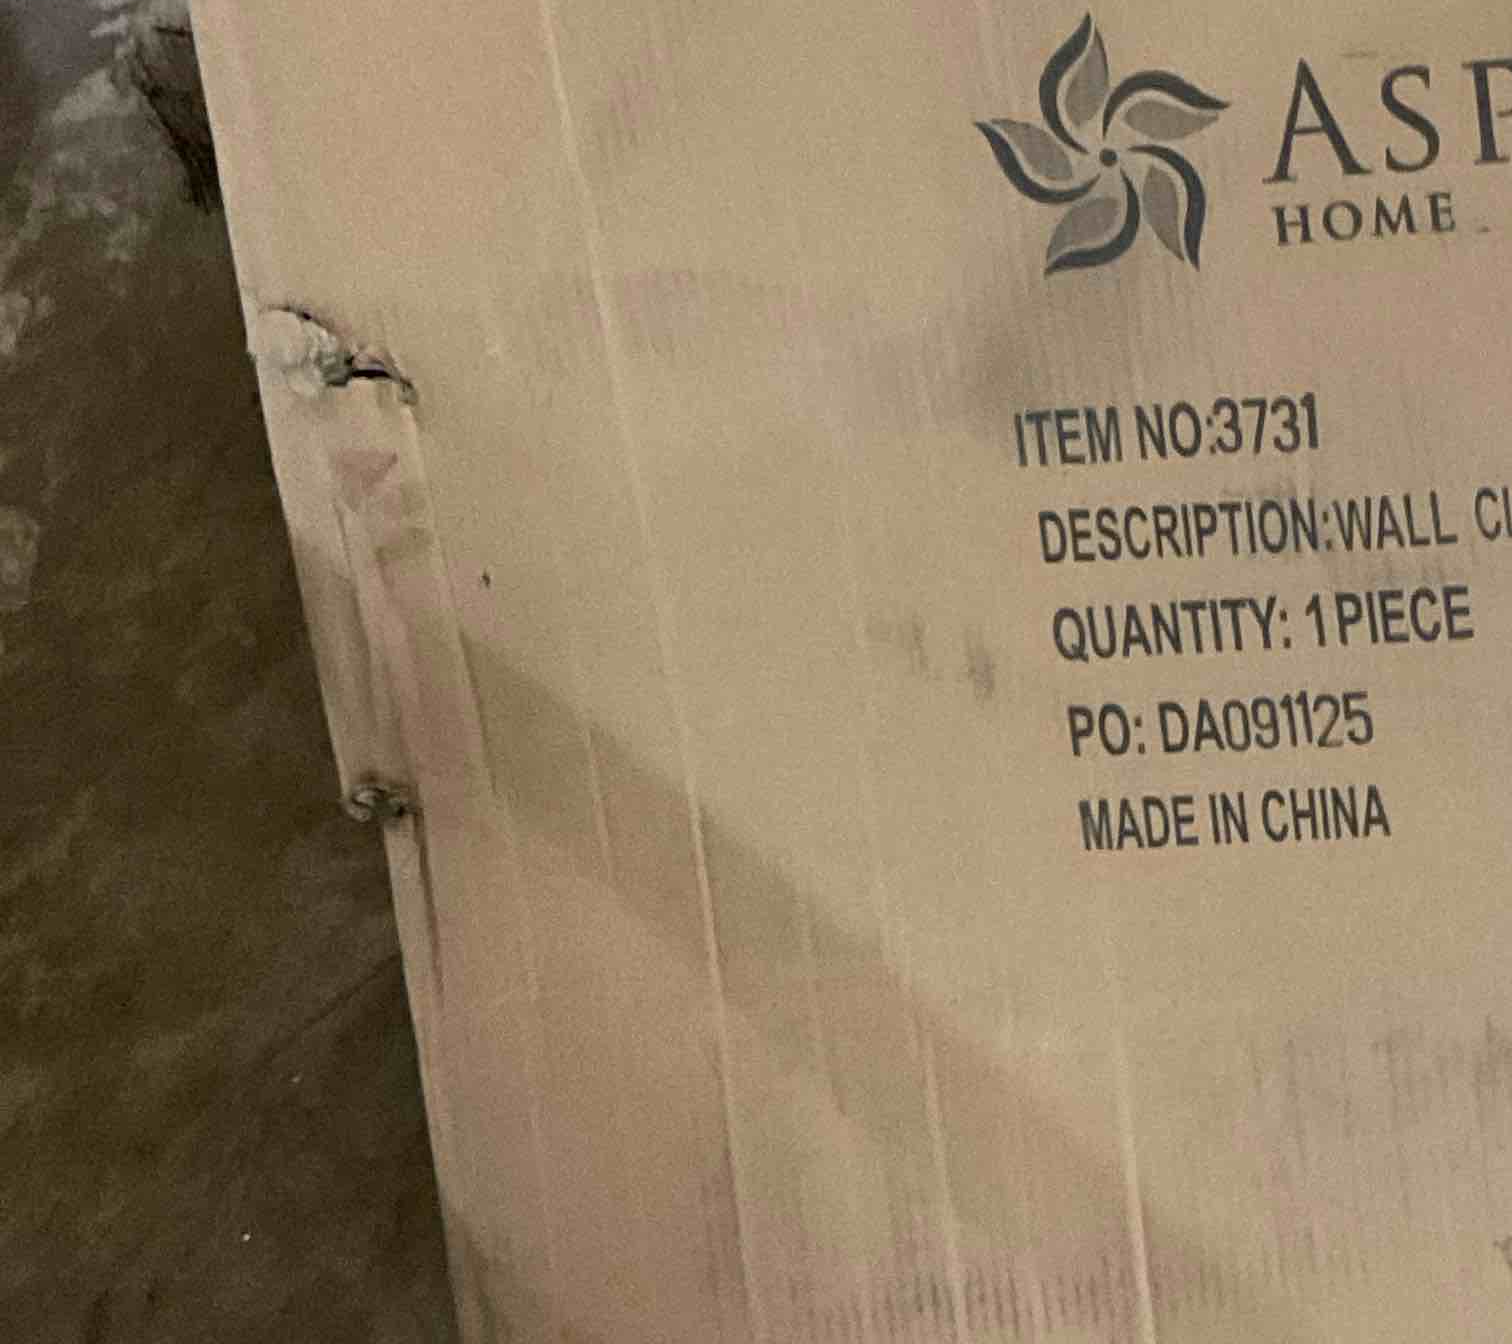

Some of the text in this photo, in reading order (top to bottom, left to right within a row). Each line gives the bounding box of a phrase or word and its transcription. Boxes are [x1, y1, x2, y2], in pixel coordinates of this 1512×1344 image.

[1272, 192, 1457, 248] HOME
[1014, 392, 1321, 468] ITEM NO:3731
[1052, 594, 1293, 664] QUANTITY:
[1067, 690, 1375, 757] PO: DA091125
[1078, 784, 1391, 852] MADE IN CHINA
